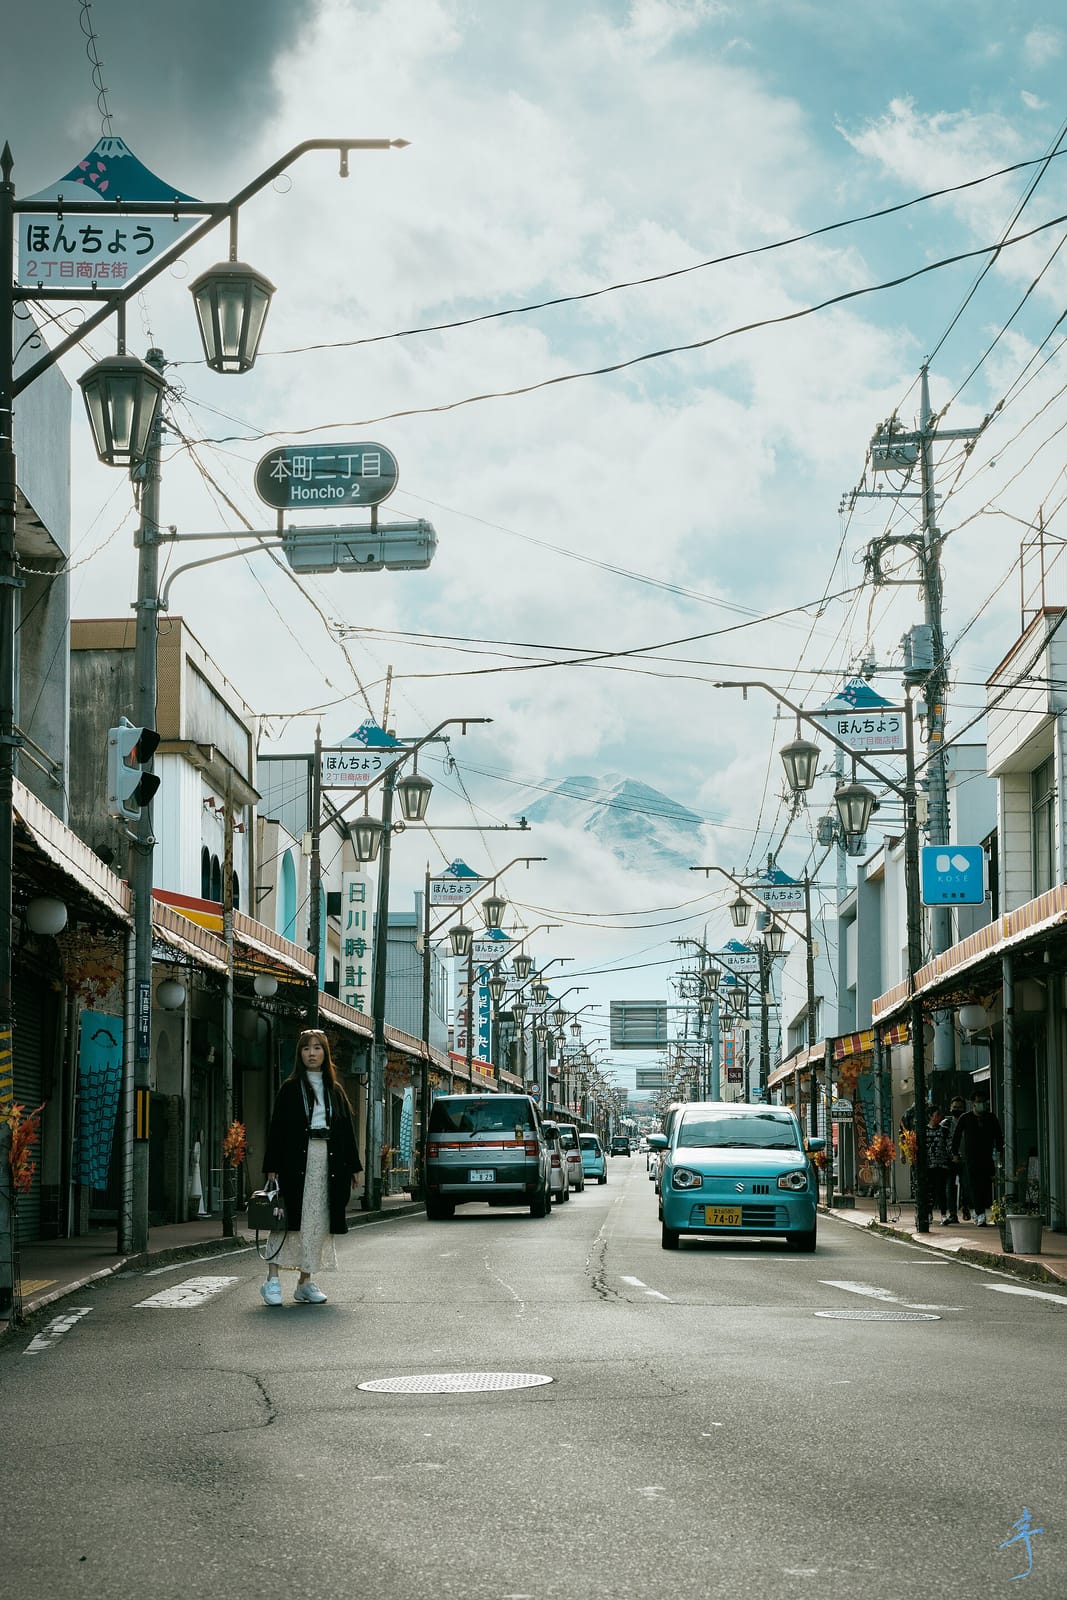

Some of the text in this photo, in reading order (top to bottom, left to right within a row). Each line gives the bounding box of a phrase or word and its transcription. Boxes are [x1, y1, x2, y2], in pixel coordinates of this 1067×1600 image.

[27, 224, 154, 255] ほんちょう
[26, 260, 128, 279] 2丁目商店街
[270, 453, 381, 483] 本町二丁目
[291, 484, 361, 500] Honcho 2
[838, 718, 900, 734] ほんちょう
[327, 756, 382, 770] ほんちょう
[433, 884, 472, 894] ほんちょう
[763, 890, 802, 900] ほんちょう
[345, 882, 367, 1012] 日川時計店
[475, 945, 505, 953] ほんちょう
[727, 956, 757, 965] ほんちょう
[714, 1214, 739, 1224] 74-07
